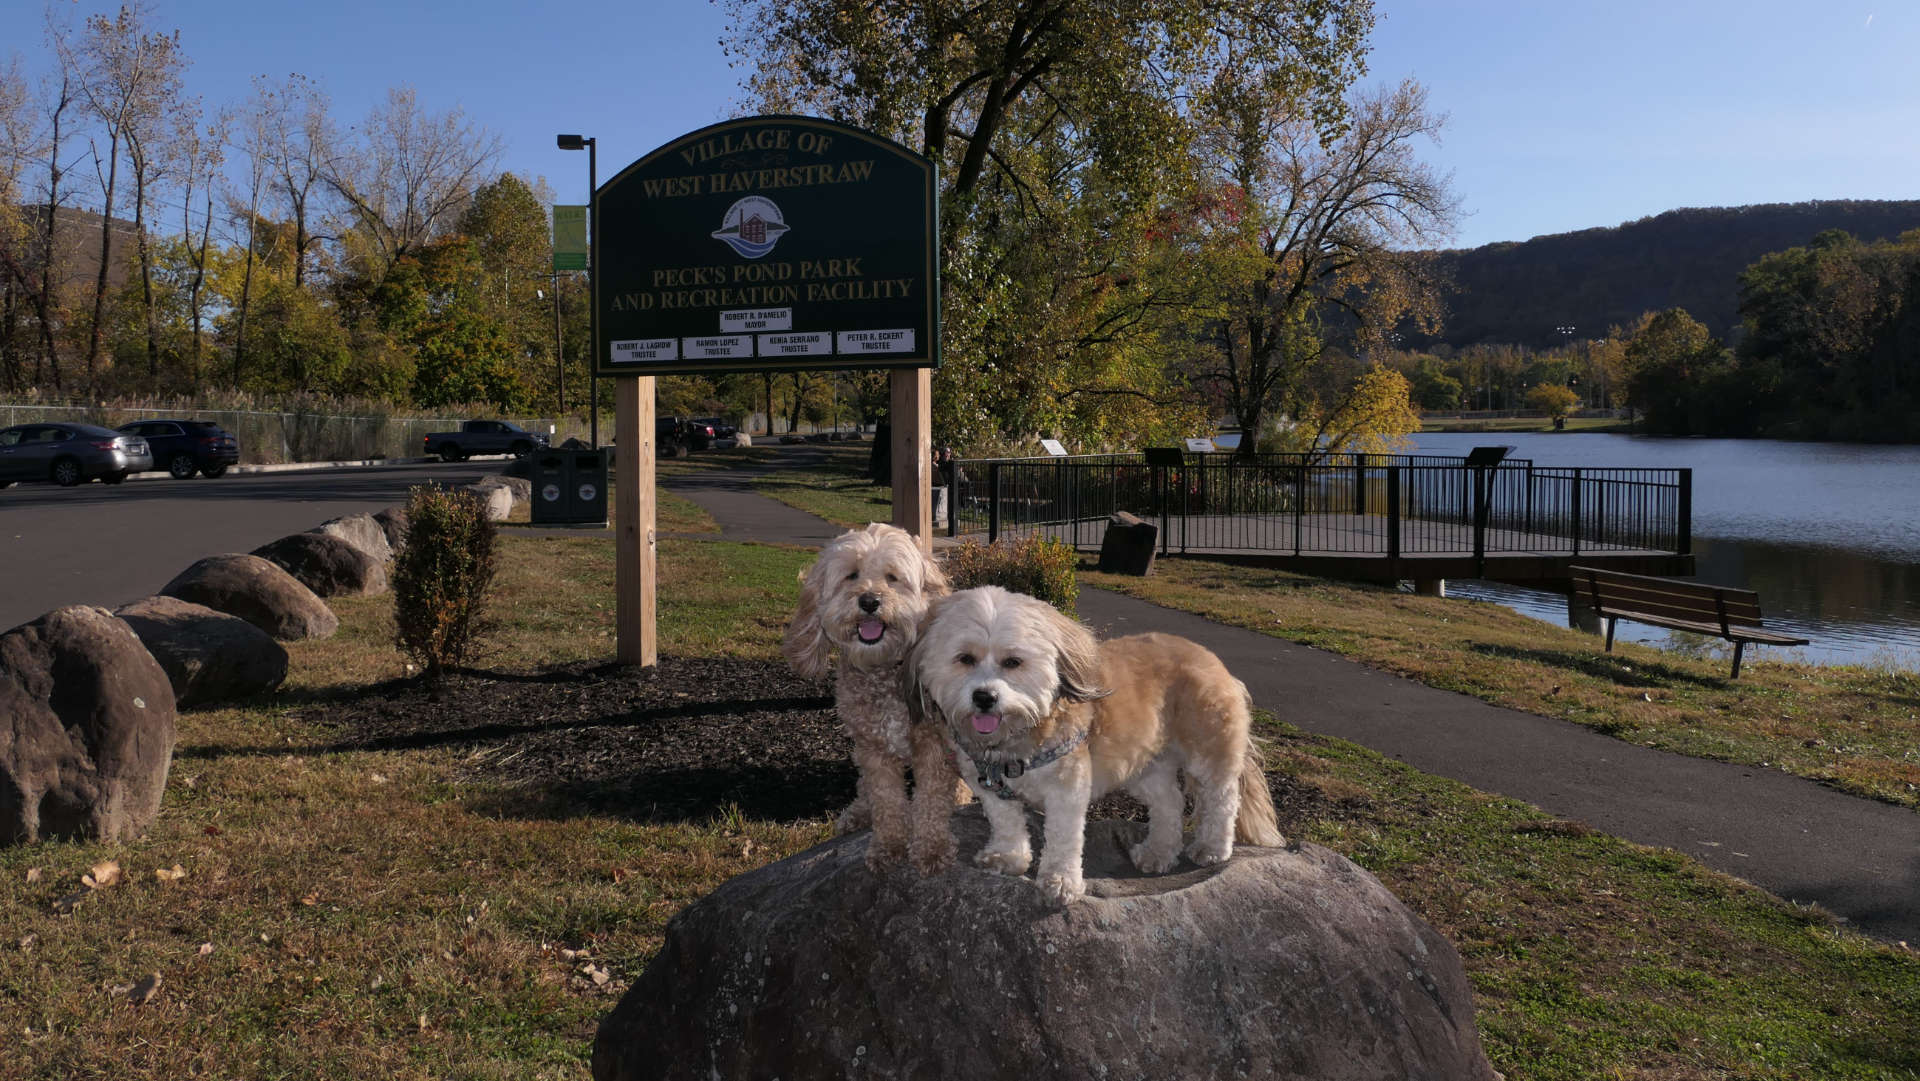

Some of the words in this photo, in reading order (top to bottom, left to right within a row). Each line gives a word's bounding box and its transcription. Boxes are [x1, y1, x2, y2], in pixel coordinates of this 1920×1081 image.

[680, 128, 791, 167] VILLAGE
[797, 131, 833, 155] OF
[643, 174, 705, 198] WEST
[710, 160, 876, 194] HAVERSTRAW
[653, 265, 727, 288] PECK'S
[733, 262, 793, 283] POND
[800, 257, 864, 279] PARK
[610, 294, 654, 312] AND
[661, 285, 799, 310] RECREATION
[807, 278, 915, 302] FACILITY
[724, 312, 748, 321] ROBERT
[758, 310, 787, 319] D'AMELIO
[744, 321, 767, 329] MAYOR
[789, 335, 820, 344] SERRANO
[847, 333, 868, 341] PETER
[879, 331, 904, 340] ECKERT
[616, 343, 638, 351] ROBERT
[696, 339, 718, 347] RAMON
[720, 338, 739, 346] LOPEZ
[861, 342, 891, 350] TRUSTEE
[704, 348, 731, 356] TRUSTEE
[780, 345, 809, 353] TRUSTEE
[631, 351, 657, 359] TRUSTEE
